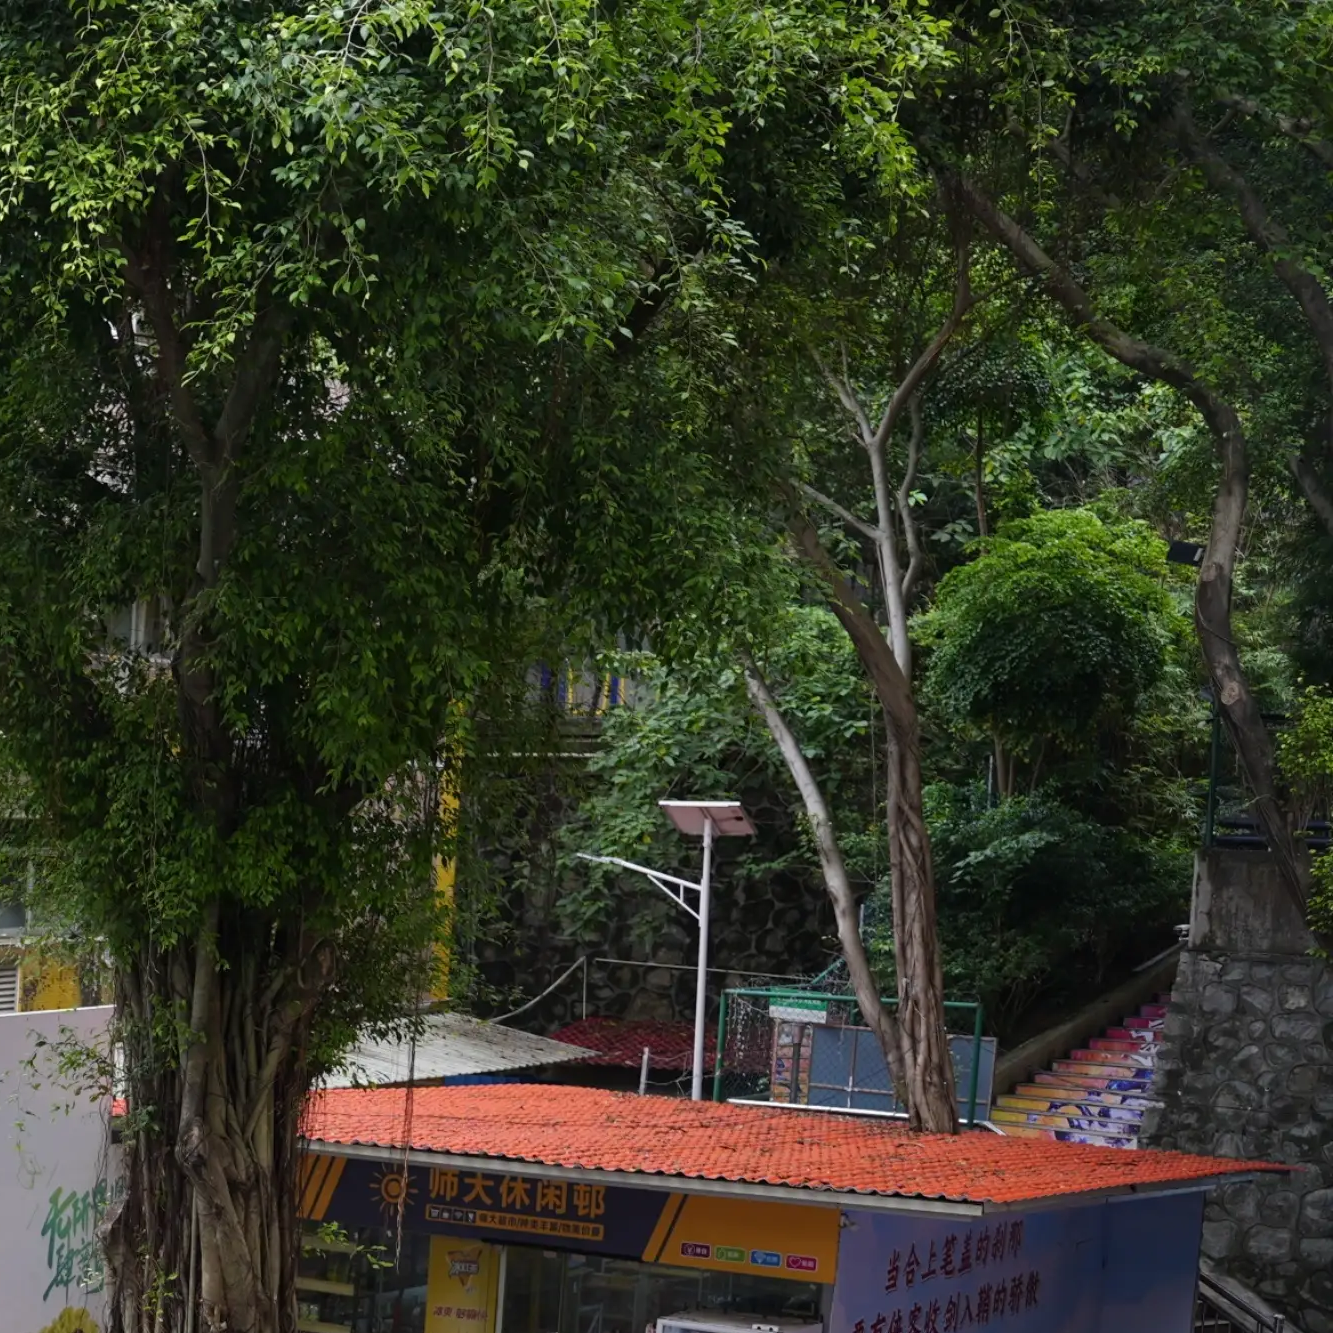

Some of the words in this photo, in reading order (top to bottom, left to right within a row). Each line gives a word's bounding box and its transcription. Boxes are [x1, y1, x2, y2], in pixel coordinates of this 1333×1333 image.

[885, 1219, 1024, 1293] 当合上笔盖的刹那
